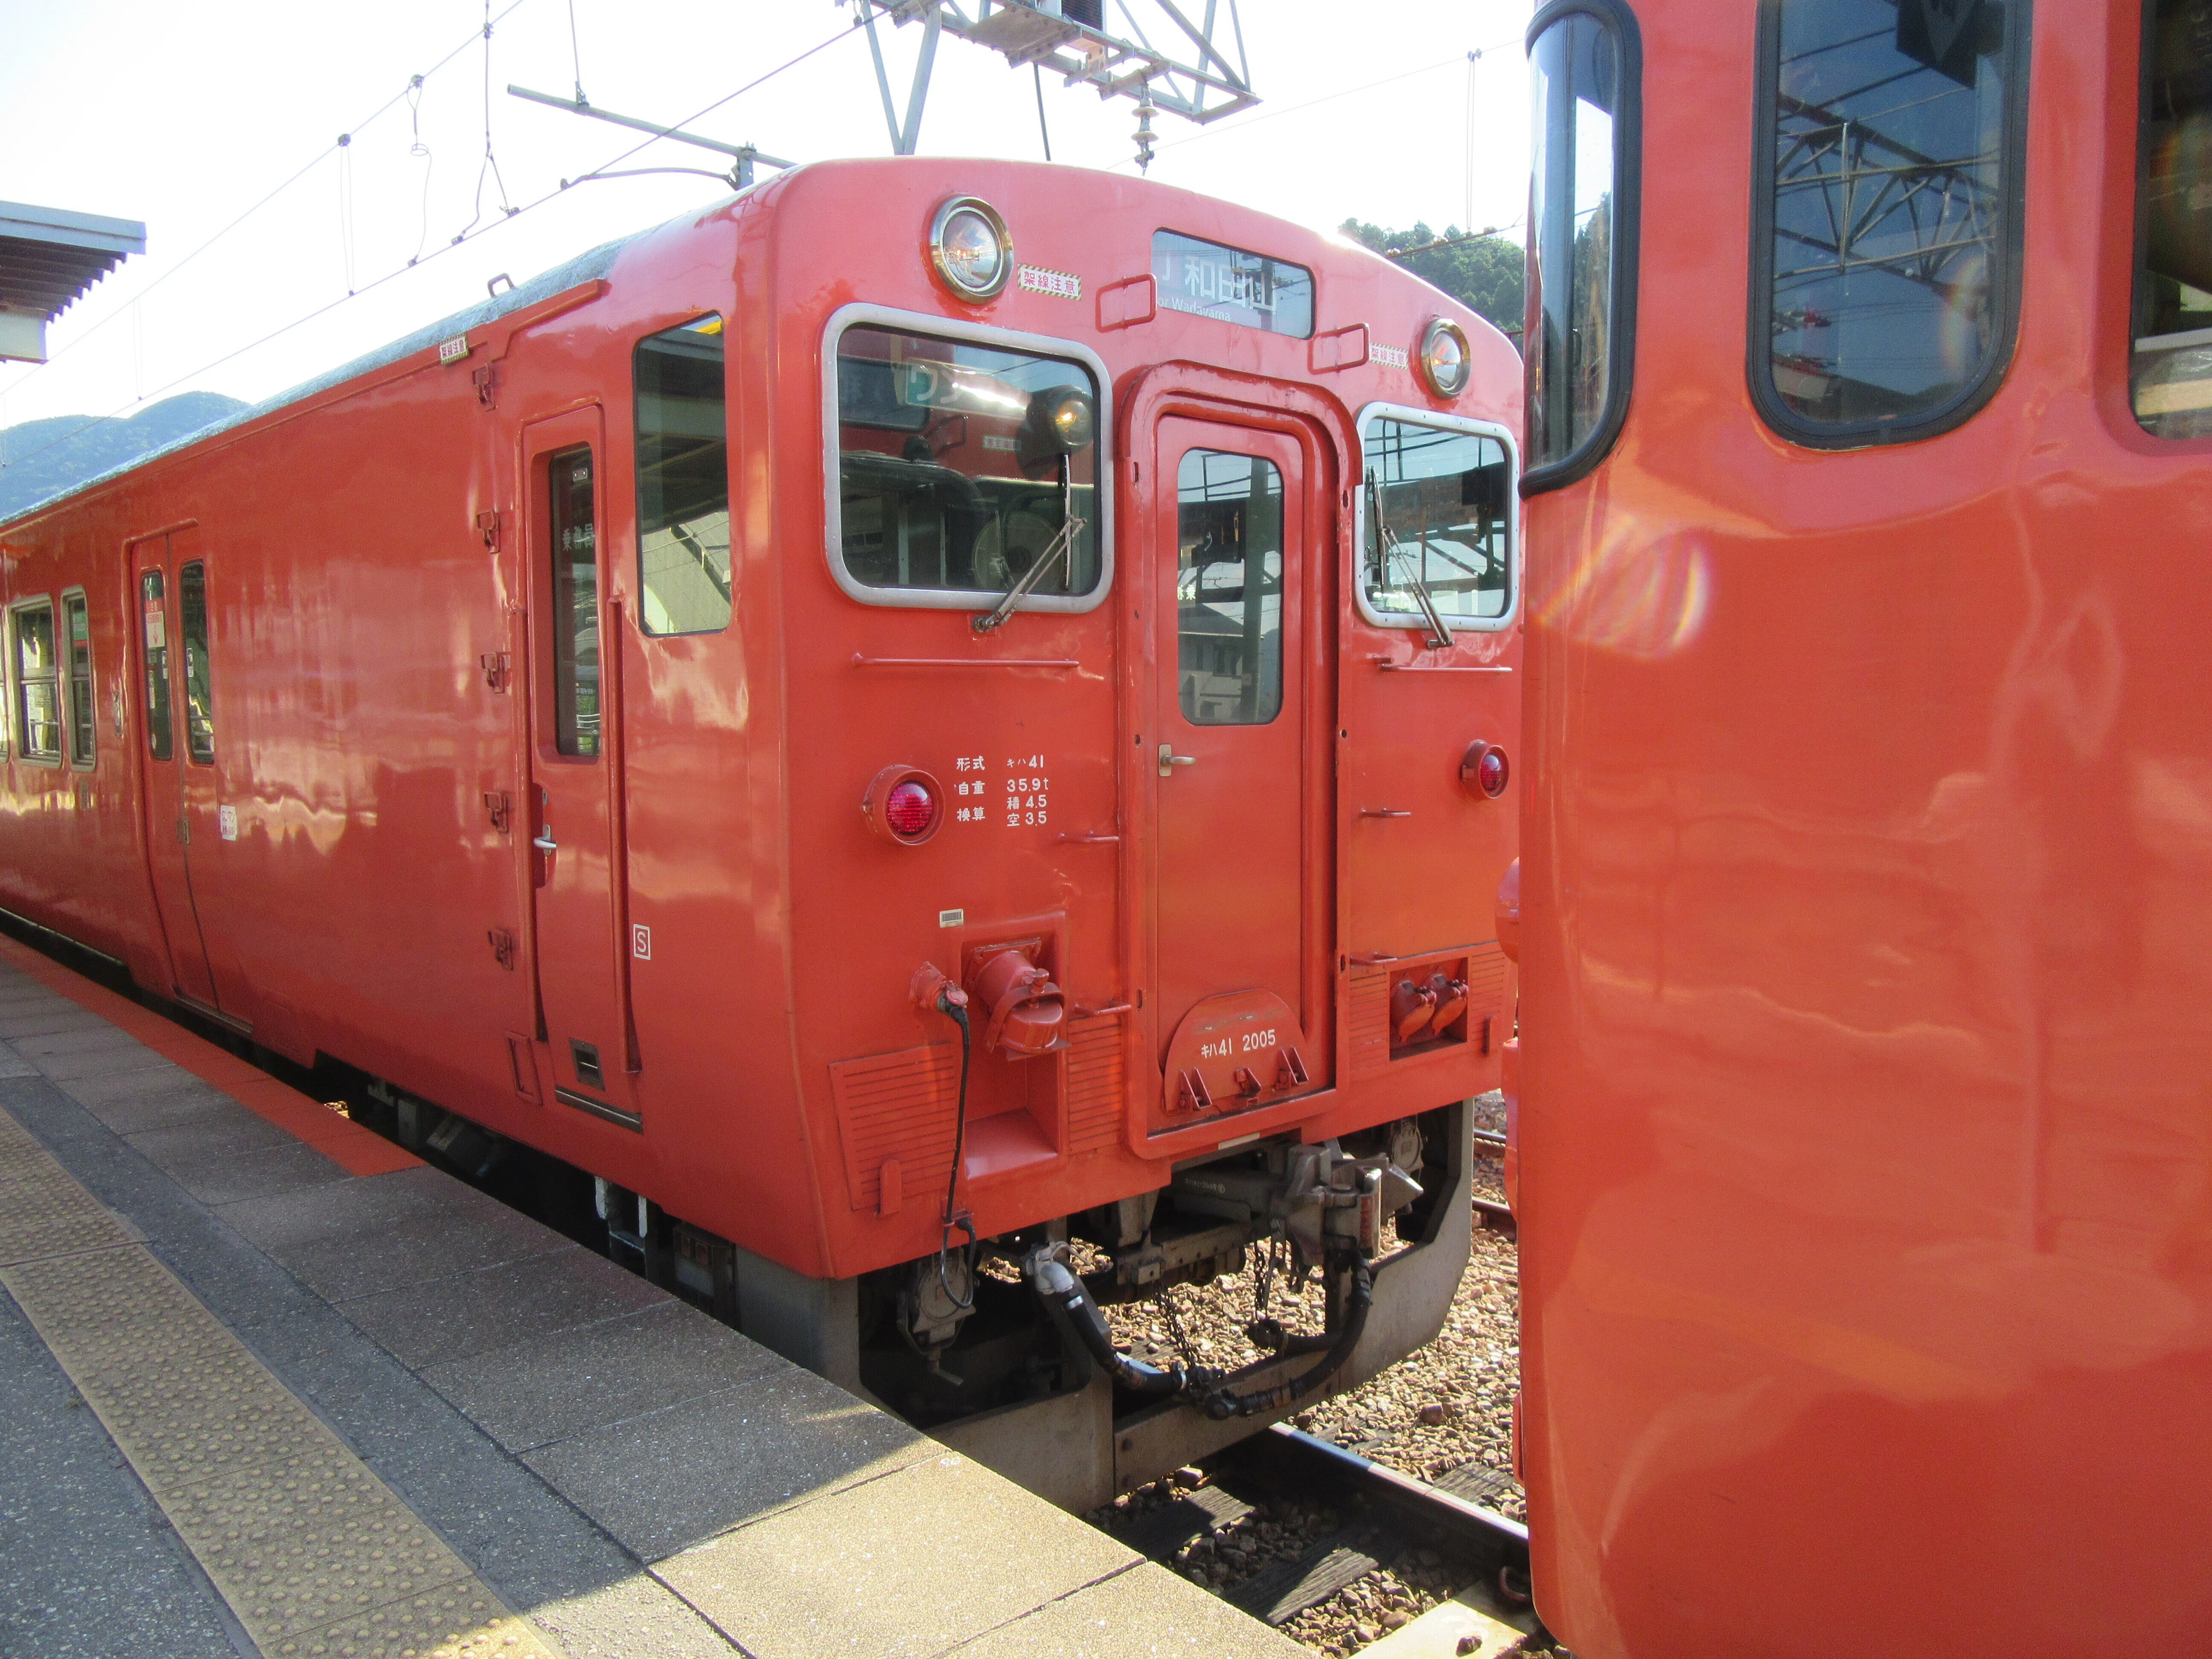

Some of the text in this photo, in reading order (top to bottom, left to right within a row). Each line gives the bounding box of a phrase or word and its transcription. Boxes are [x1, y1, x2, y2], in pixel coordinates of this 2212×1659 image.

[1024, 271, 1075, 294] 架線注意
[956, 754, 1044, 771] 形式 キハ41
[958, 780, 985, 795] 自重
[957, 806, 985, 822] 換算
[1007, 796, 1020, 810] 積
[1007, 813, 1020, 827] 空
[1201, 1029, 1276, 1059] キハ41 2005
